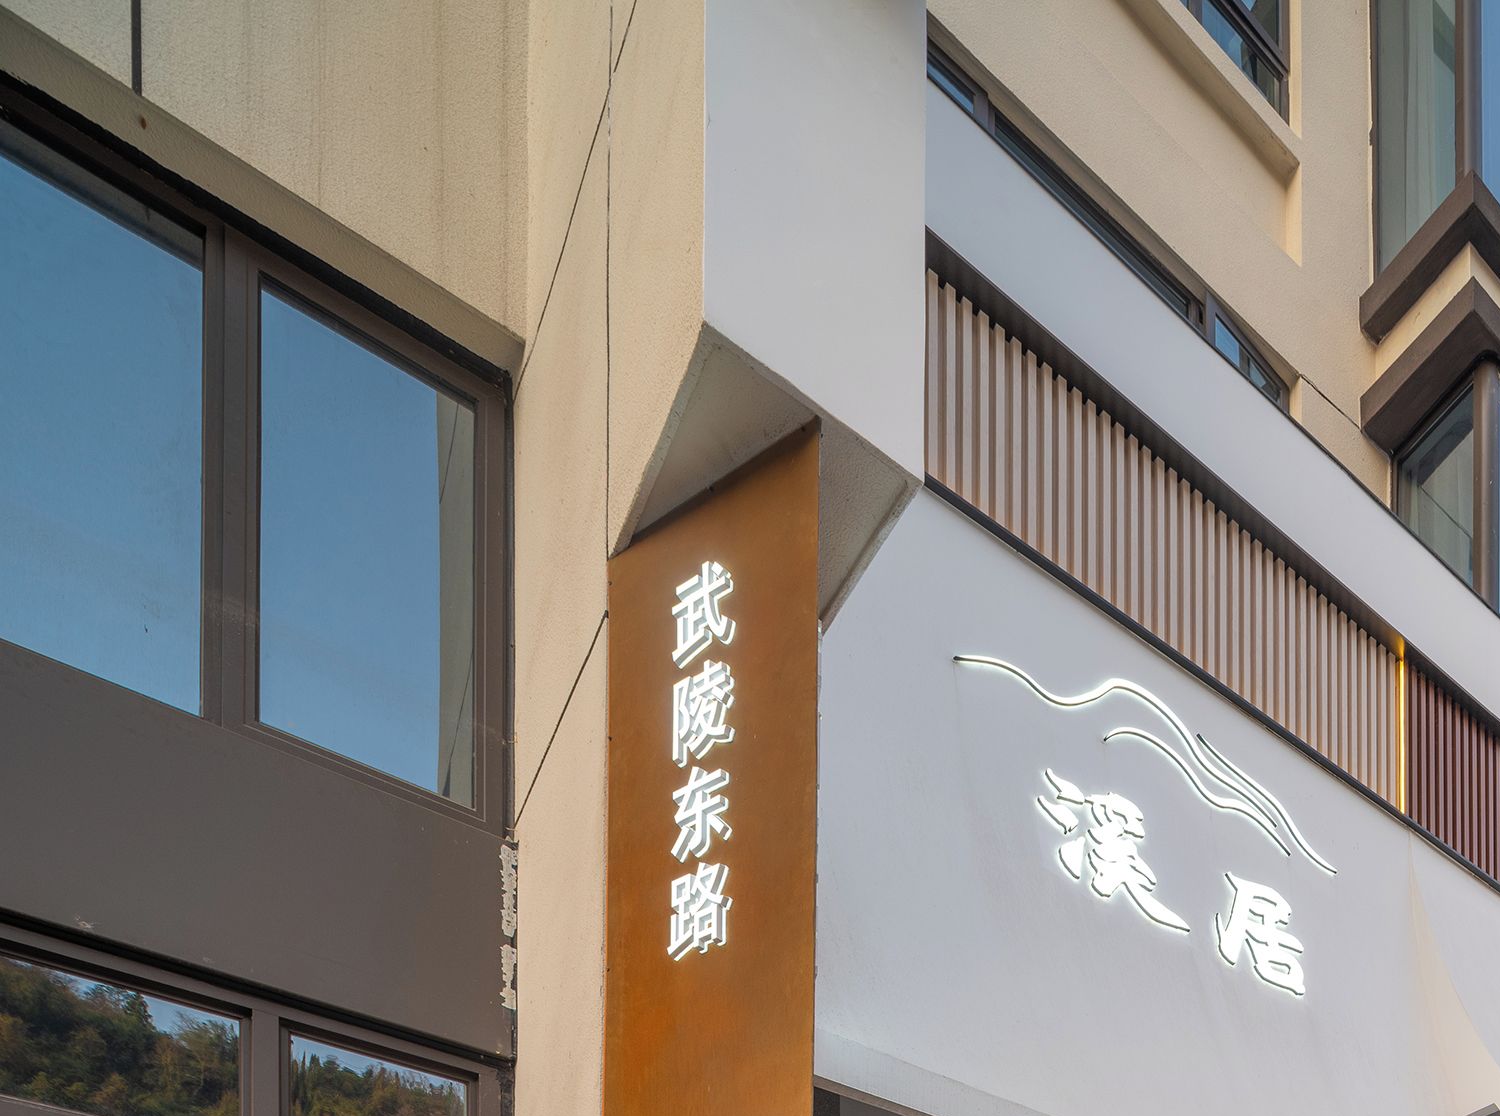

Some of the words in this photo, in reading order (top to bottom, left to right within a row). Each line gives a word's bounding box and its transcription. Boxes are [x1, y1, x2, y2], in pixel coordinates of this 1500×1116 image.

[668, 560, 736, 962] 武陵东路
[1036, 768, 1306, 997] 溪居
